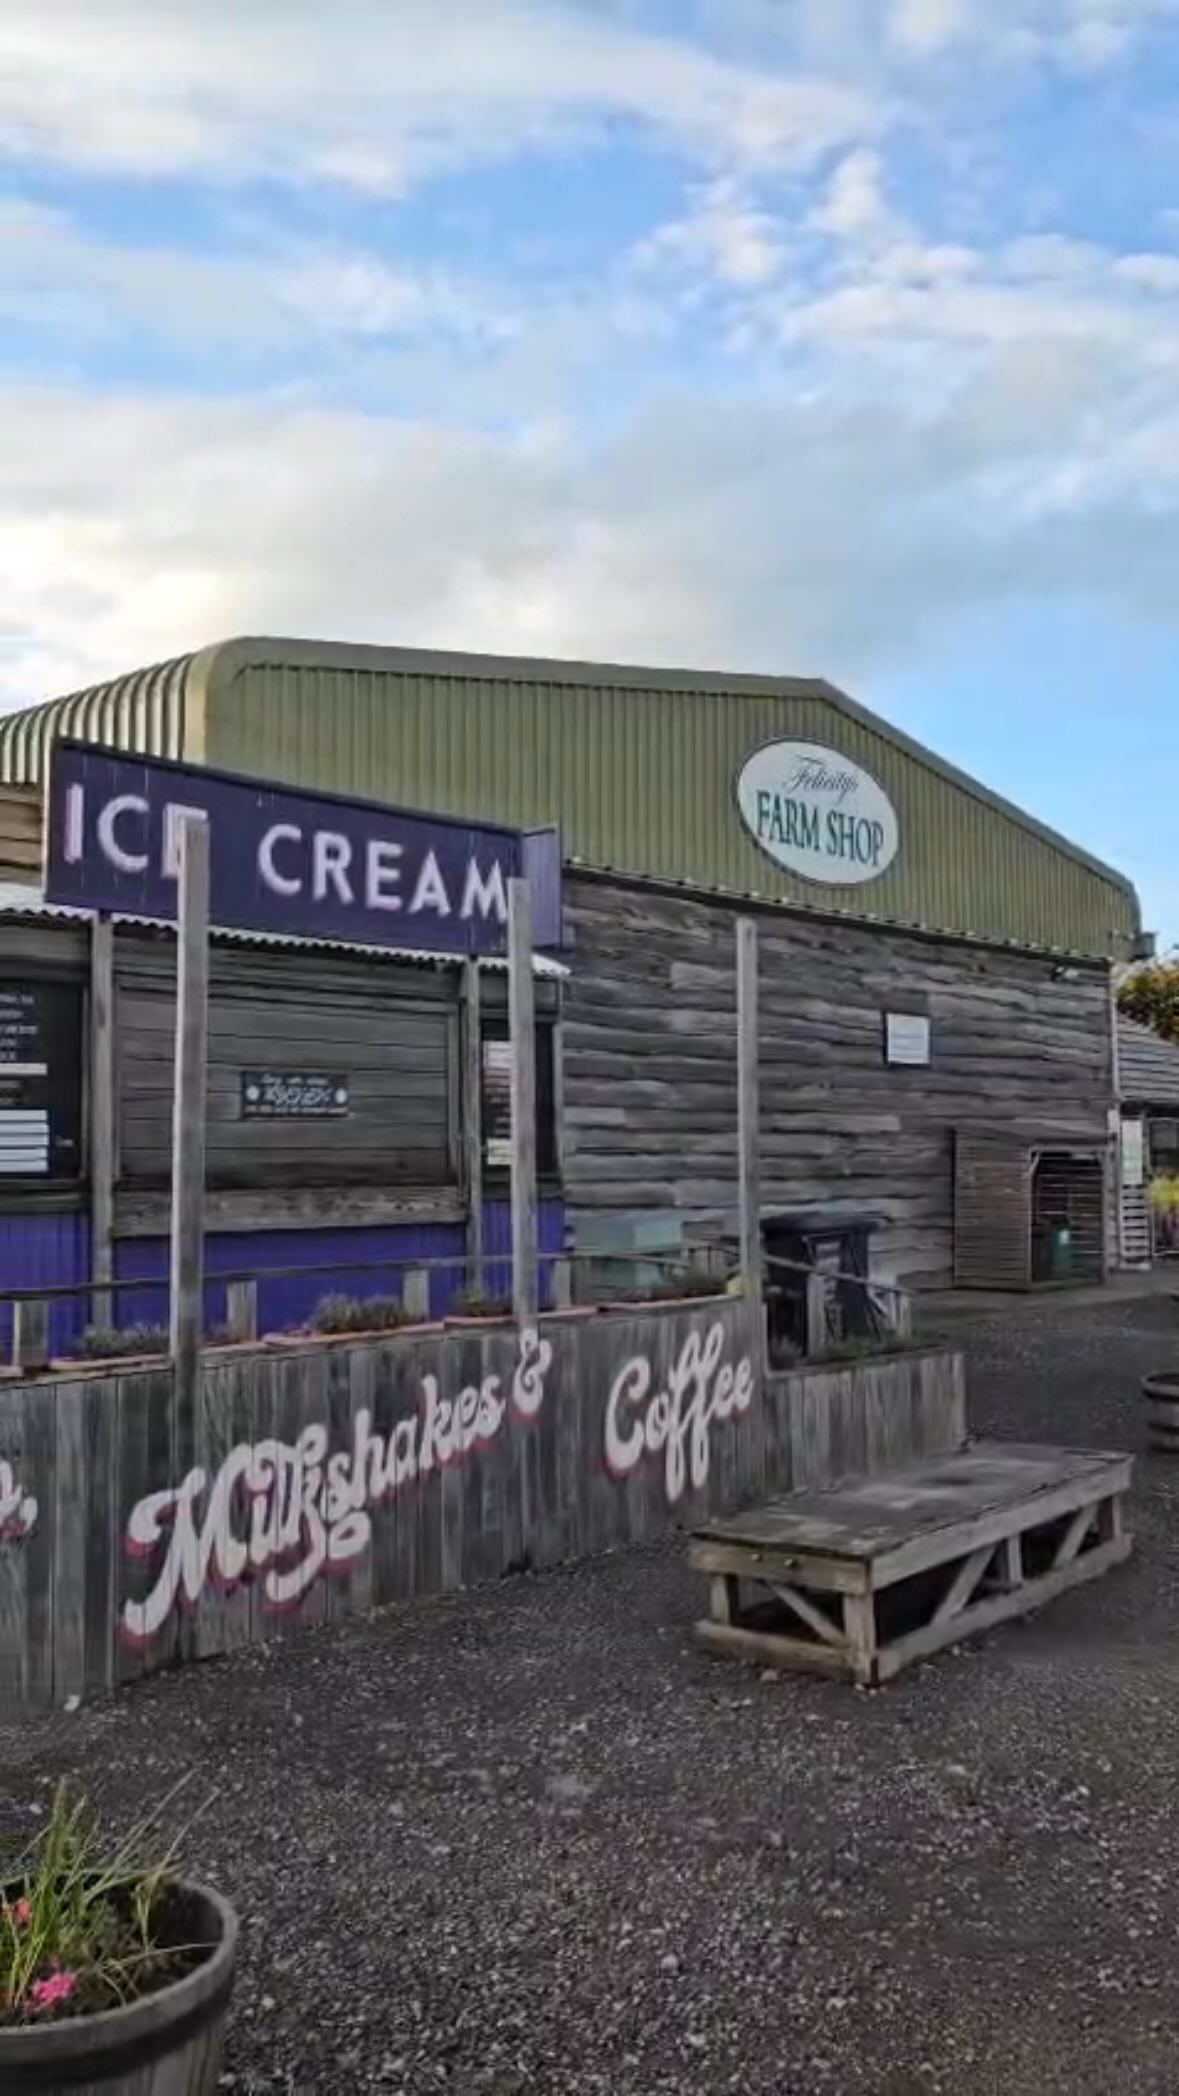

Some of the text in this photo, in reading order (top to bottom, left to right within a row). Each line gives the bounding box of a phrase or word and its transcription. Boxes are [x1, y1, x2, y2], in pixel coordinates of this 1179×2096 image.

[257, 823, 508, 922] CREAM
[757, 789, 884, 867] FARM SHOP
[122, 1374, 504, 1640] Milkshakes
[513, 1328, 551, 1415] &
[604, 1321, 754, 1501] Coffee
